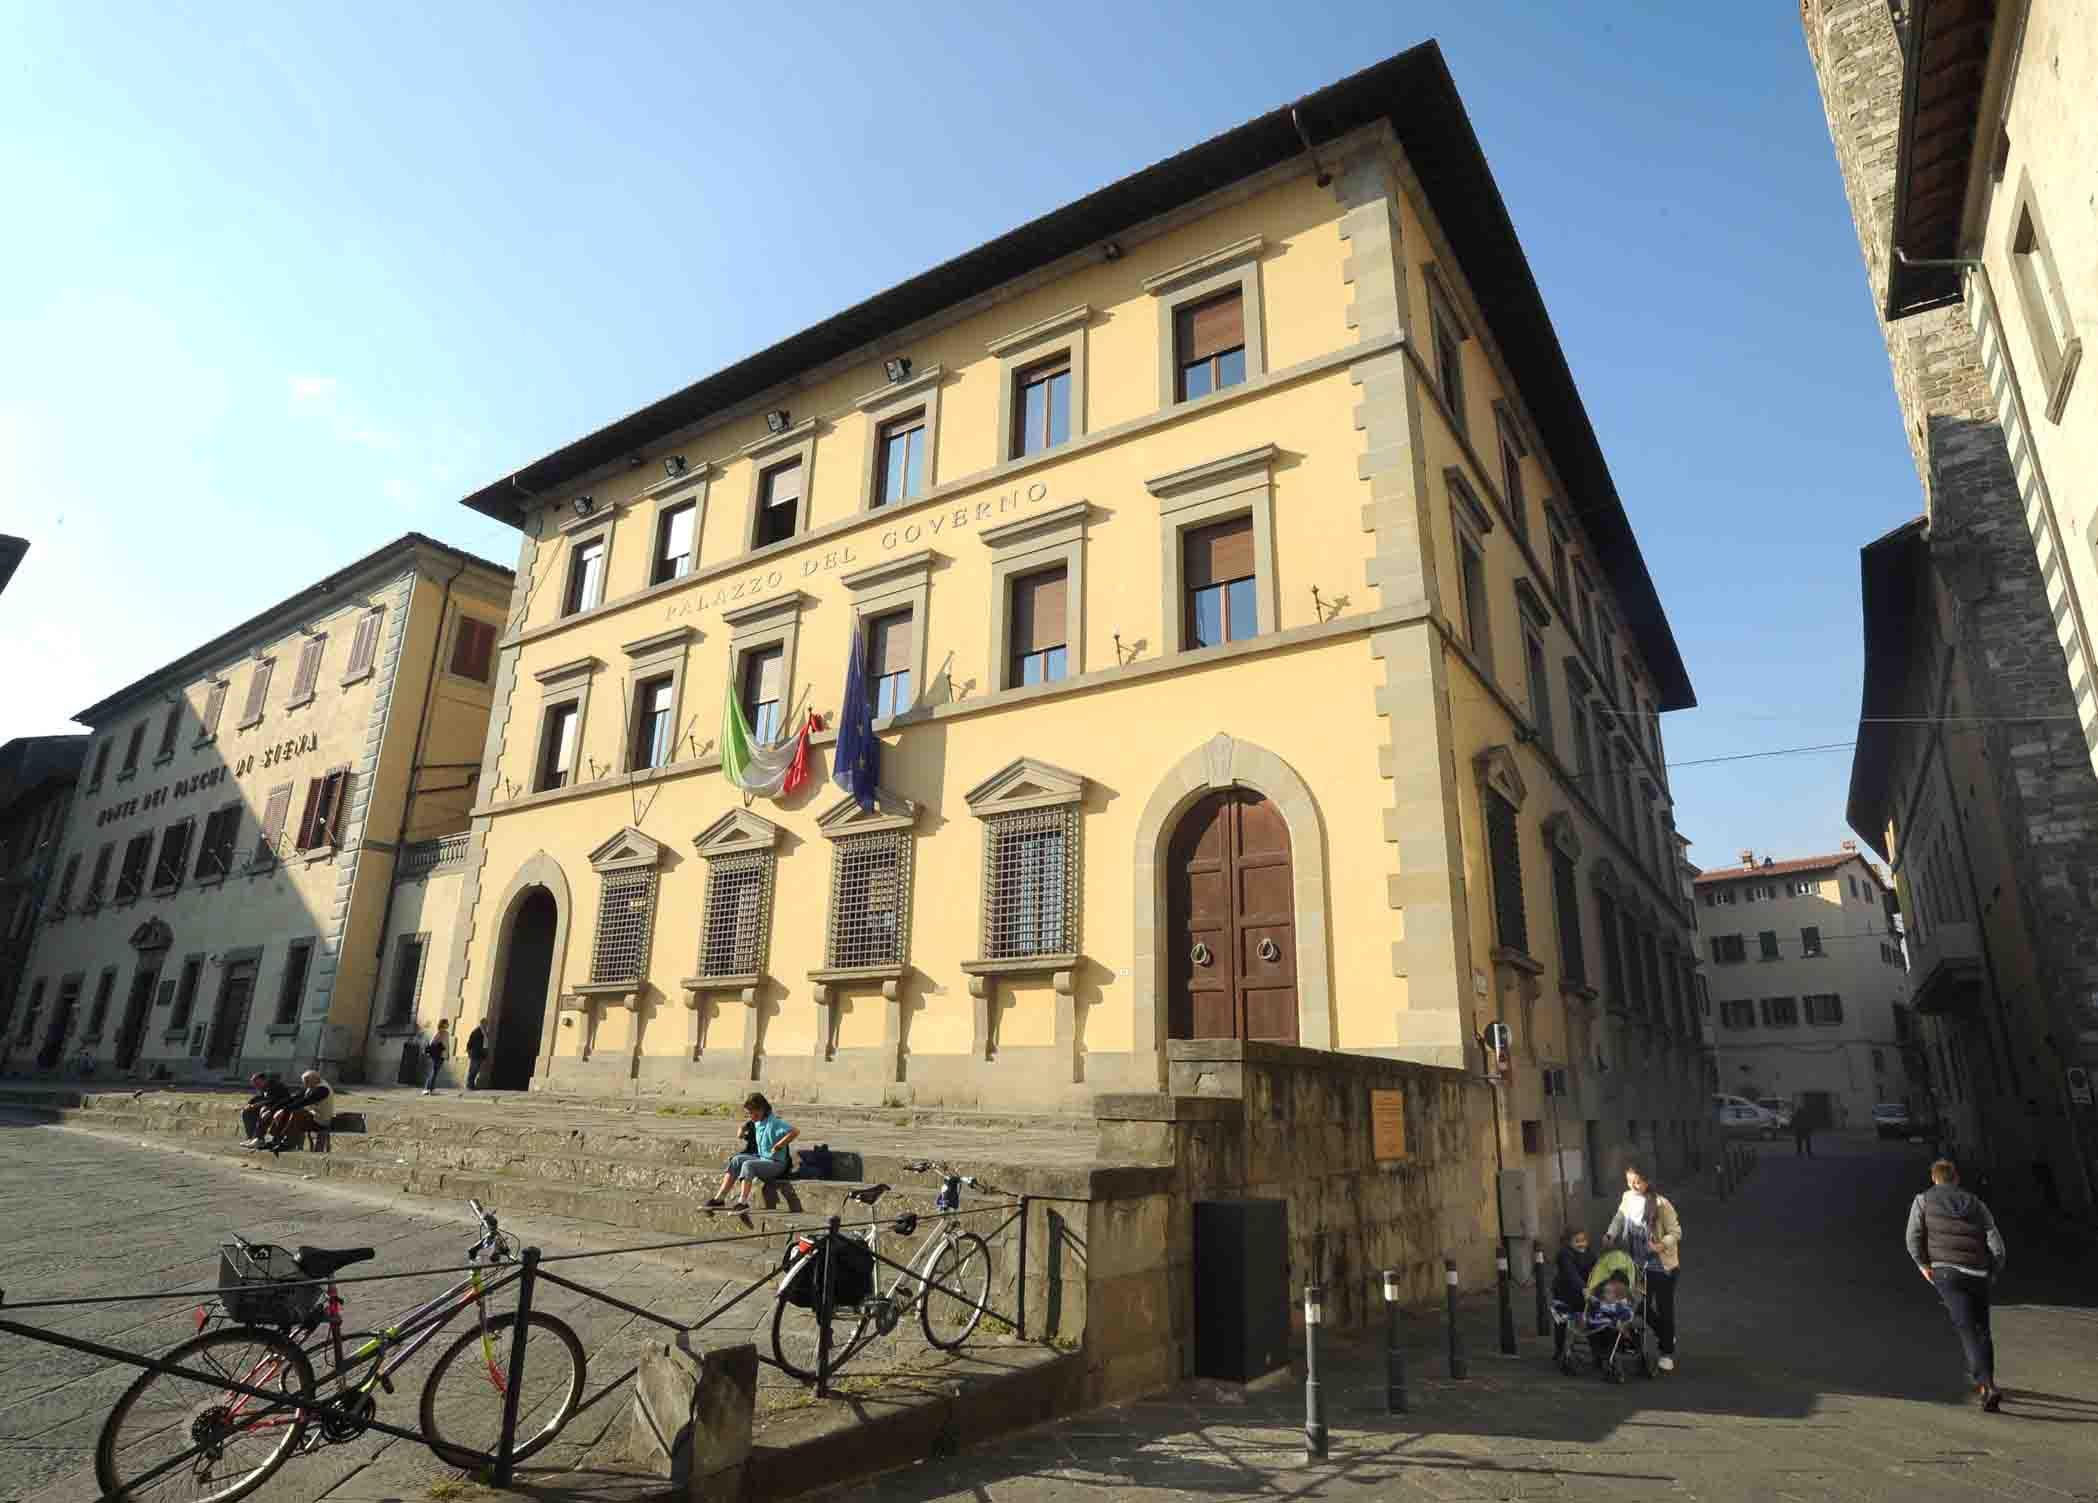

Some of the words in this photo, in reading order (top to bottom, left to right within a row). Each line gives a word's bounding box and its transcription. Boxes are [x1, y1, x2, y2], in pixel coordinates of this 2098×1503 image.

[665, 571, 783, 621] PALAZZO
[801, 547, 857, 576] DEL
[881, 482, 1048, 551] GOVERNO
